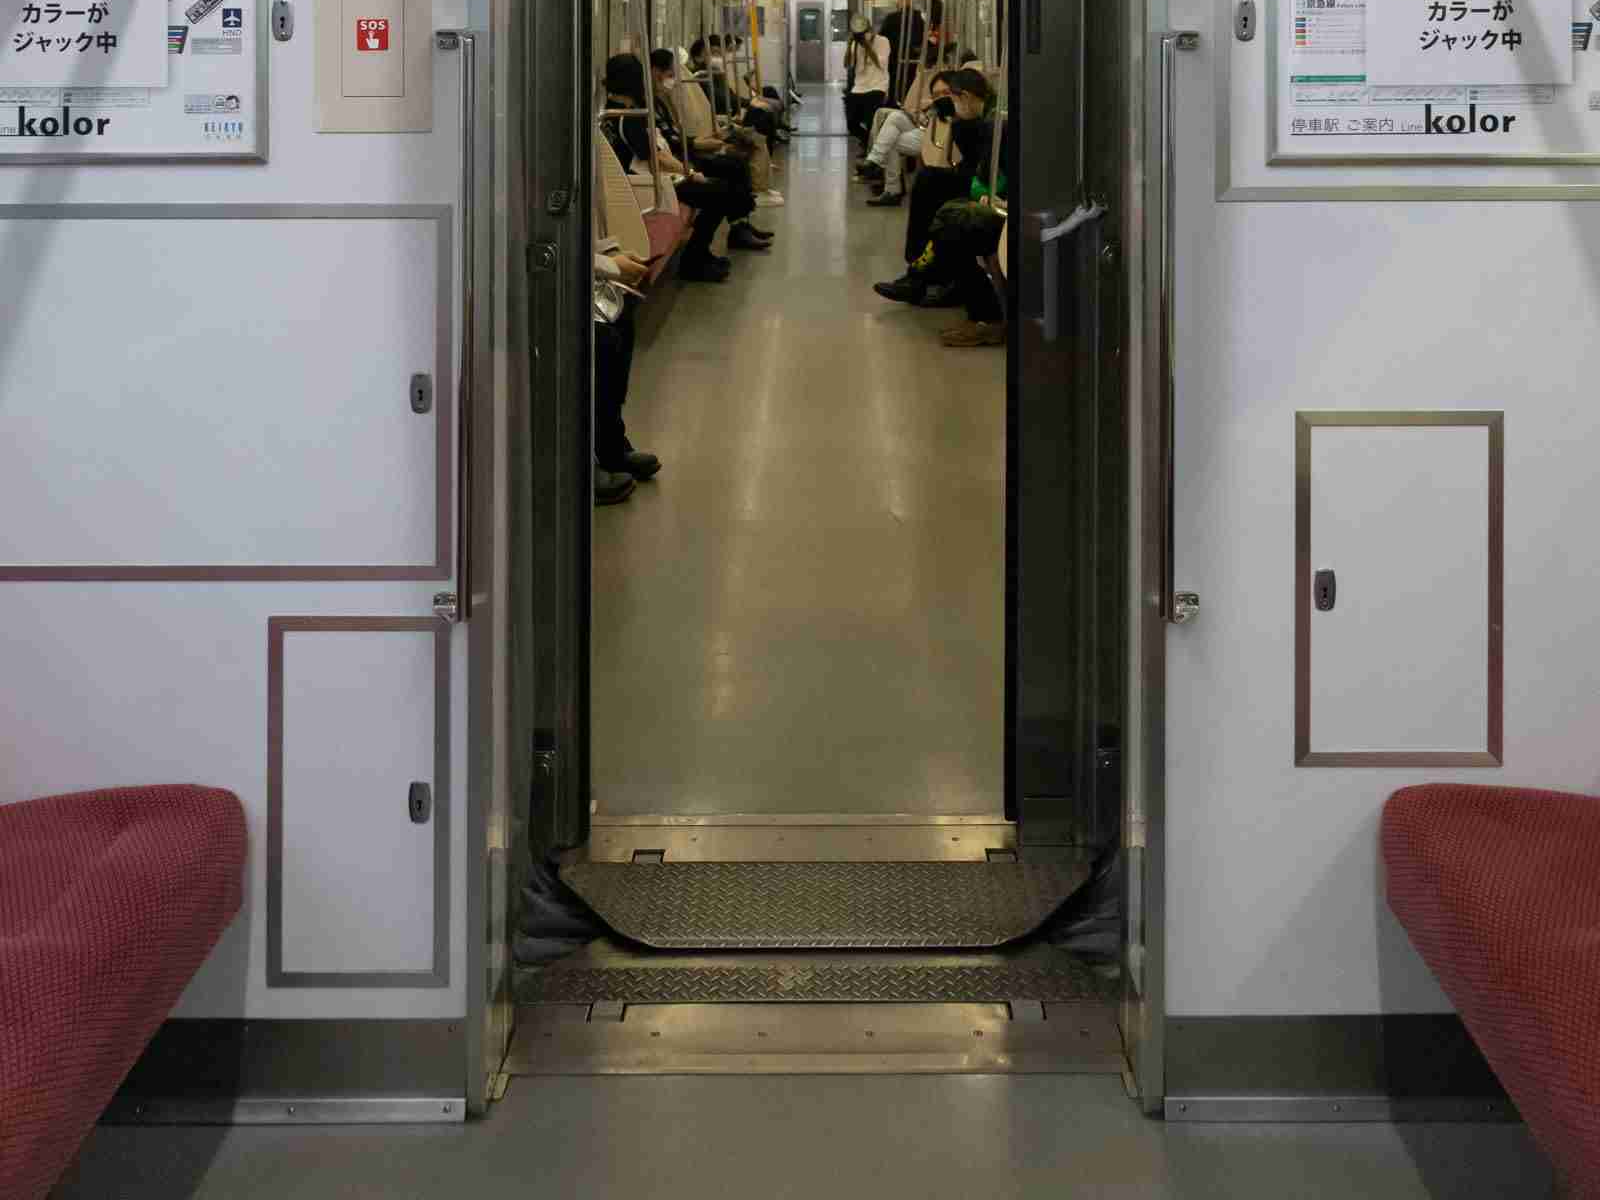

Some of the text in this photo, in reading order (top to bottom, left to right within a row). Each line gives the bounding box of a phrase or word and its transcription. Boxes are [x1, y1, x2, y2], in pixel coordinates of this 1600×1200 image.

[21, 3, 111, 26] カラーが
[1428, 0, 1514, 23] カラーが
[360, 20, 386, 31] SOS
[12, 30, 119, 55] ジャック中
[1418, 28, 1523, 52] ジャック中
[17, 105, 111, 136] kolor
[1424, 103, 1517, 134] kolor
